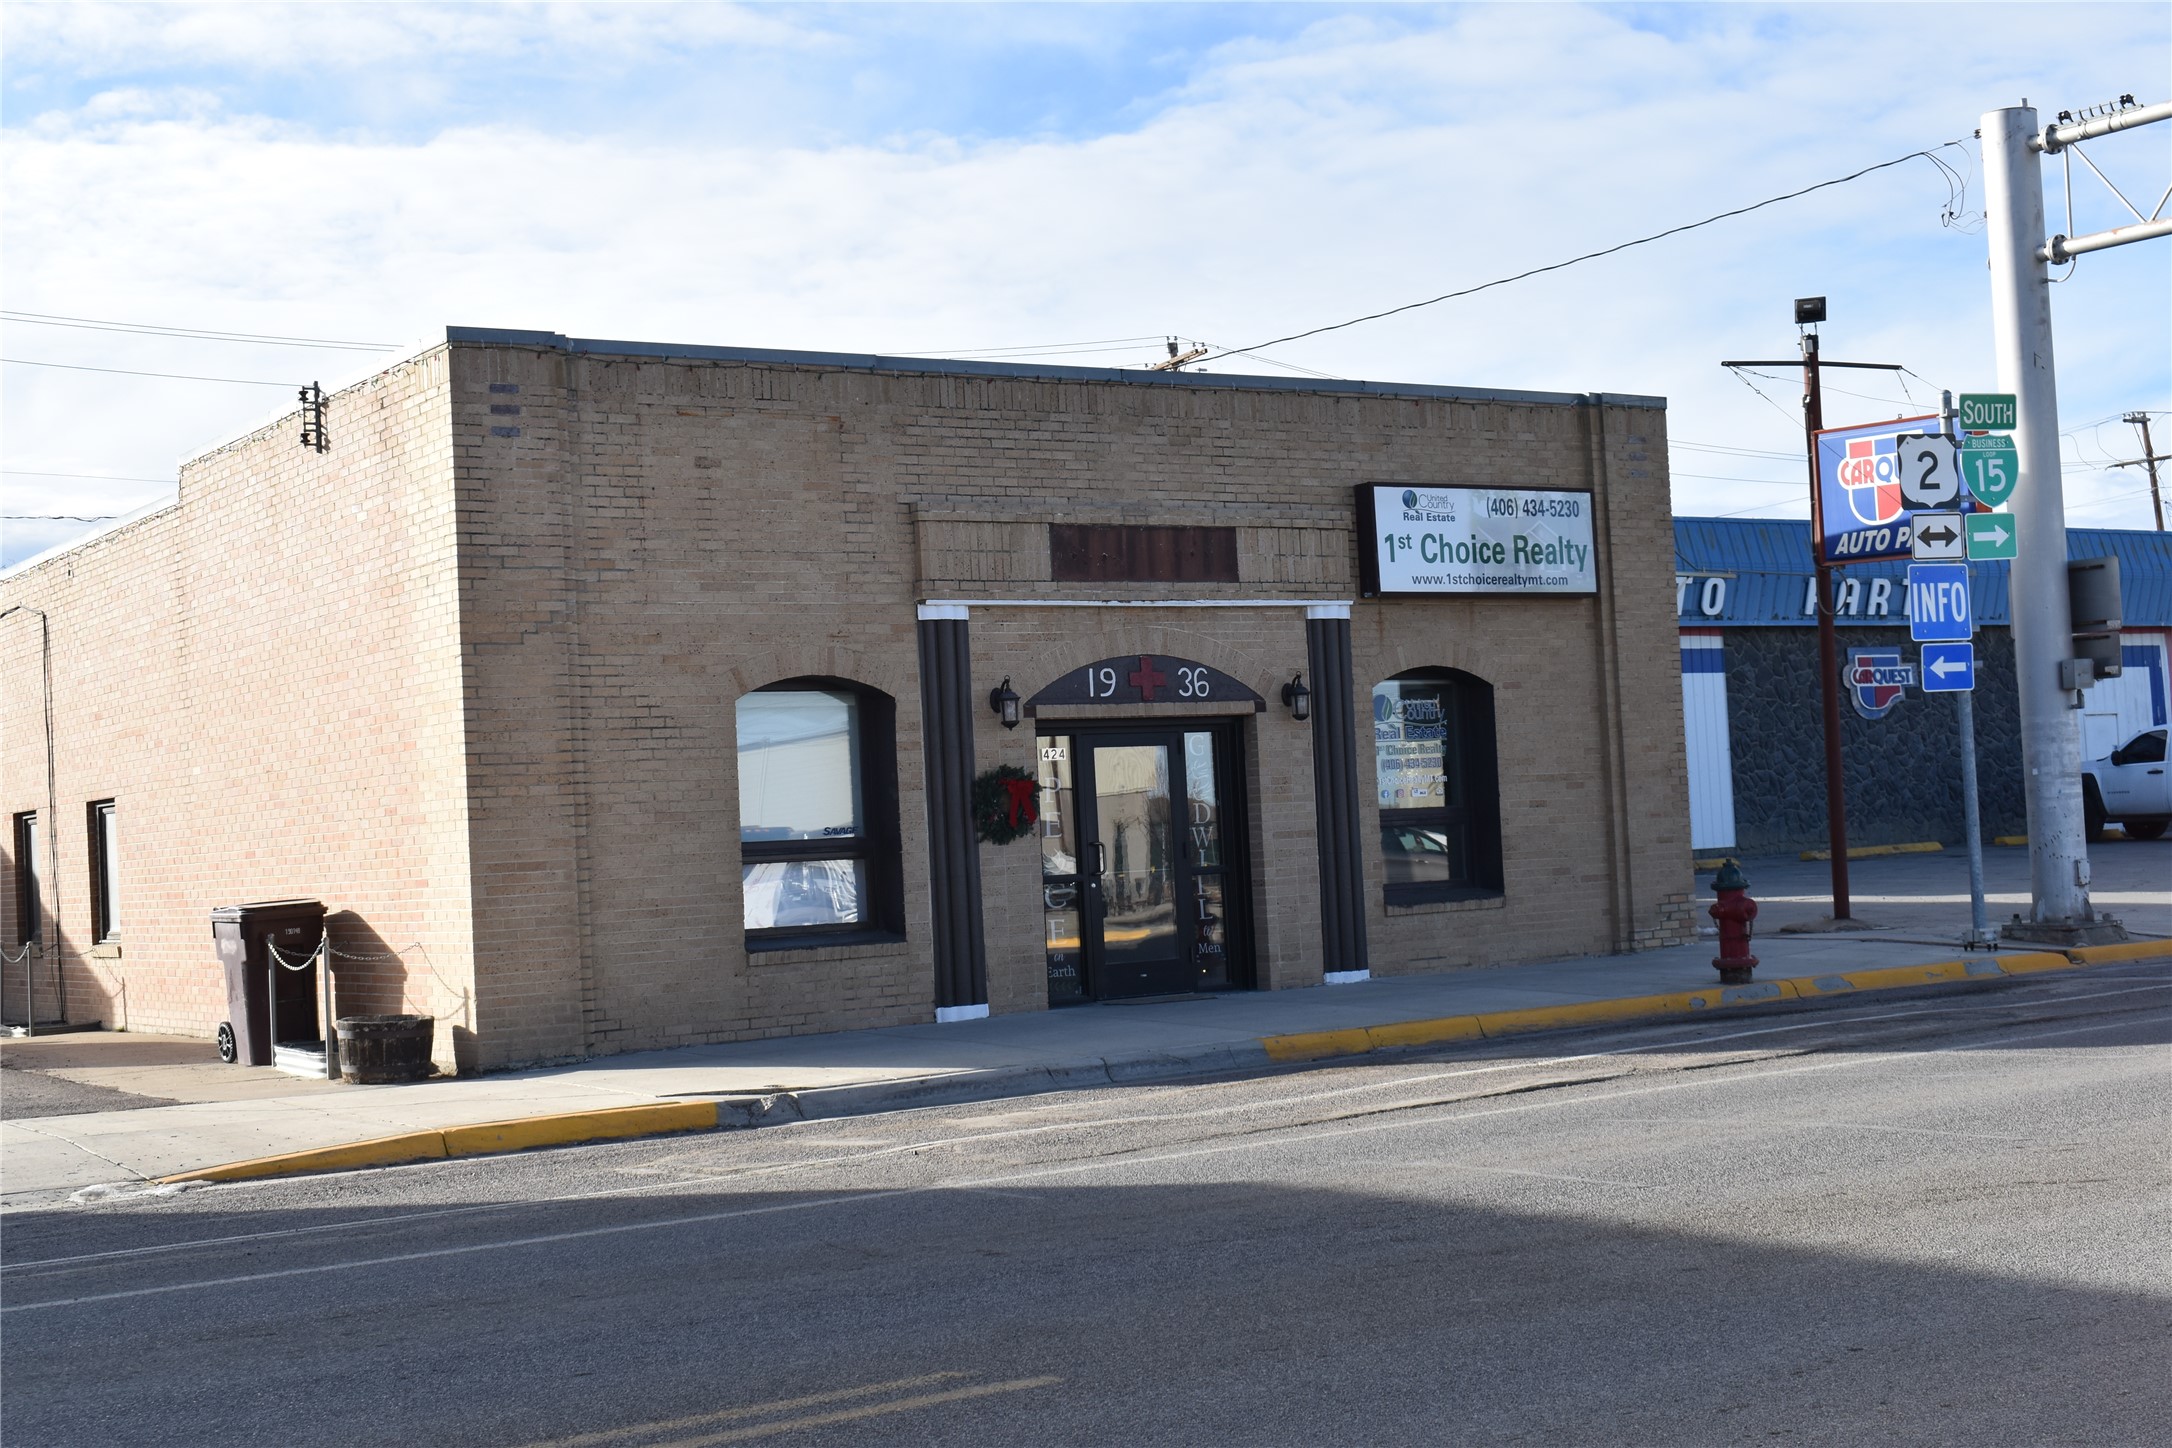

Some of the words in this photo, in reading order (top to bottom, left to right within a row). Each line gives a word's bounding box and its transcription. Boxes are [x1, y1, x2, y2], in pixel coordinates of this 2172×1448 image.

[1963, 400, 2014, 425] SOUTH
[1971, 439, 2007, 449] BUSINESS
[1917, 450, 1941, 490] 2
[1975, 458, 2007, 492] 15
[1403, 512, 1424, 522] Real
[1427, 513, 1456, 523] Estate
[1486, 496, 1519, 519] (406)
[1522, 499, 1580, 518] 434-5230
[1384, 533, 1412, 563] 1st
[1420, 533, 1505, 564] Choice
[1513, 534, 1588, 572] Realty
[1834, 527, 1891, 555] AUTO
[1411, 573, 1569, 588] www.1stchoicerealtymt.com
[1912, 581, 1967, 623] INFO
[1088, 667, 1117, 698] 19
[1177, 667, 1211, 698] 36
[1852, 668, 1911, 685] CARQUEST
[1405, 725, 1447, 739] Estate
[1043, 748, 1066, 760] 424
[1198, 942, 1222, 954] Men
